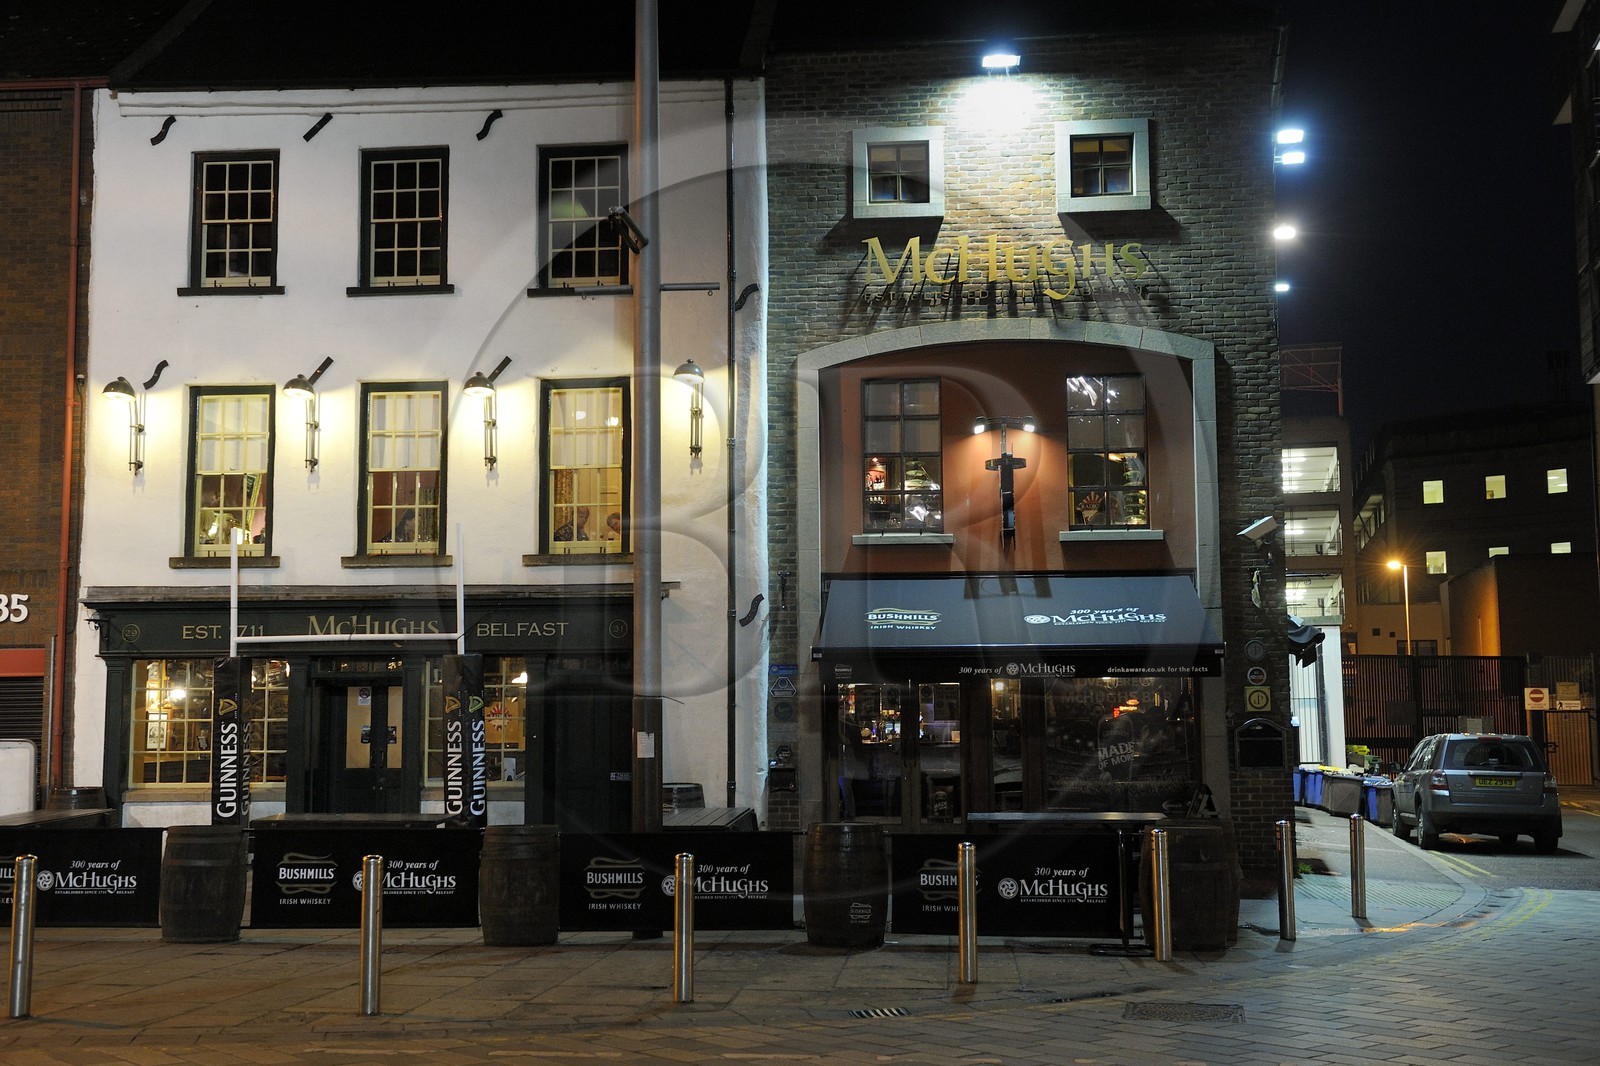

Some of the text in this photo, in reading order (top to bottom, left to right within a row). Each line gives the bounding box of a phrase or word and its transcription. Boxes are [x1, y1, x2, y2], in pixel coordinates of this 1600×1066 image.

[183, 625, 222, 639] EST.
[229, 625, 264, 638] 711
[476, 622, 569, 637] BELFAST
[959, 666, 972, 674] 300
[973, 667, 992, 675] years
[994, 666, 1003, 675] of
[217, 722, 238, 818] GUINNESS
[241, 721, 252, 816] GUINNESS
[446, 720, 463, 815] GUINNESS
[470, 720, 486, 816] GUINNESS
[1478, 778, 1492, 786] UEZ
[70, 860, 121, 870] 300 years of
[387, 860, 439, 870] 300 years of
[698, 863, 751, 874] 300 years of
[279, 867, 335, 879] BUSHMILLS
[587, 871, 643, 884] BUSHMILLS
[1034, 867, 1089, 878] 300 years of
[922, 904, 942, 912] IRISH
